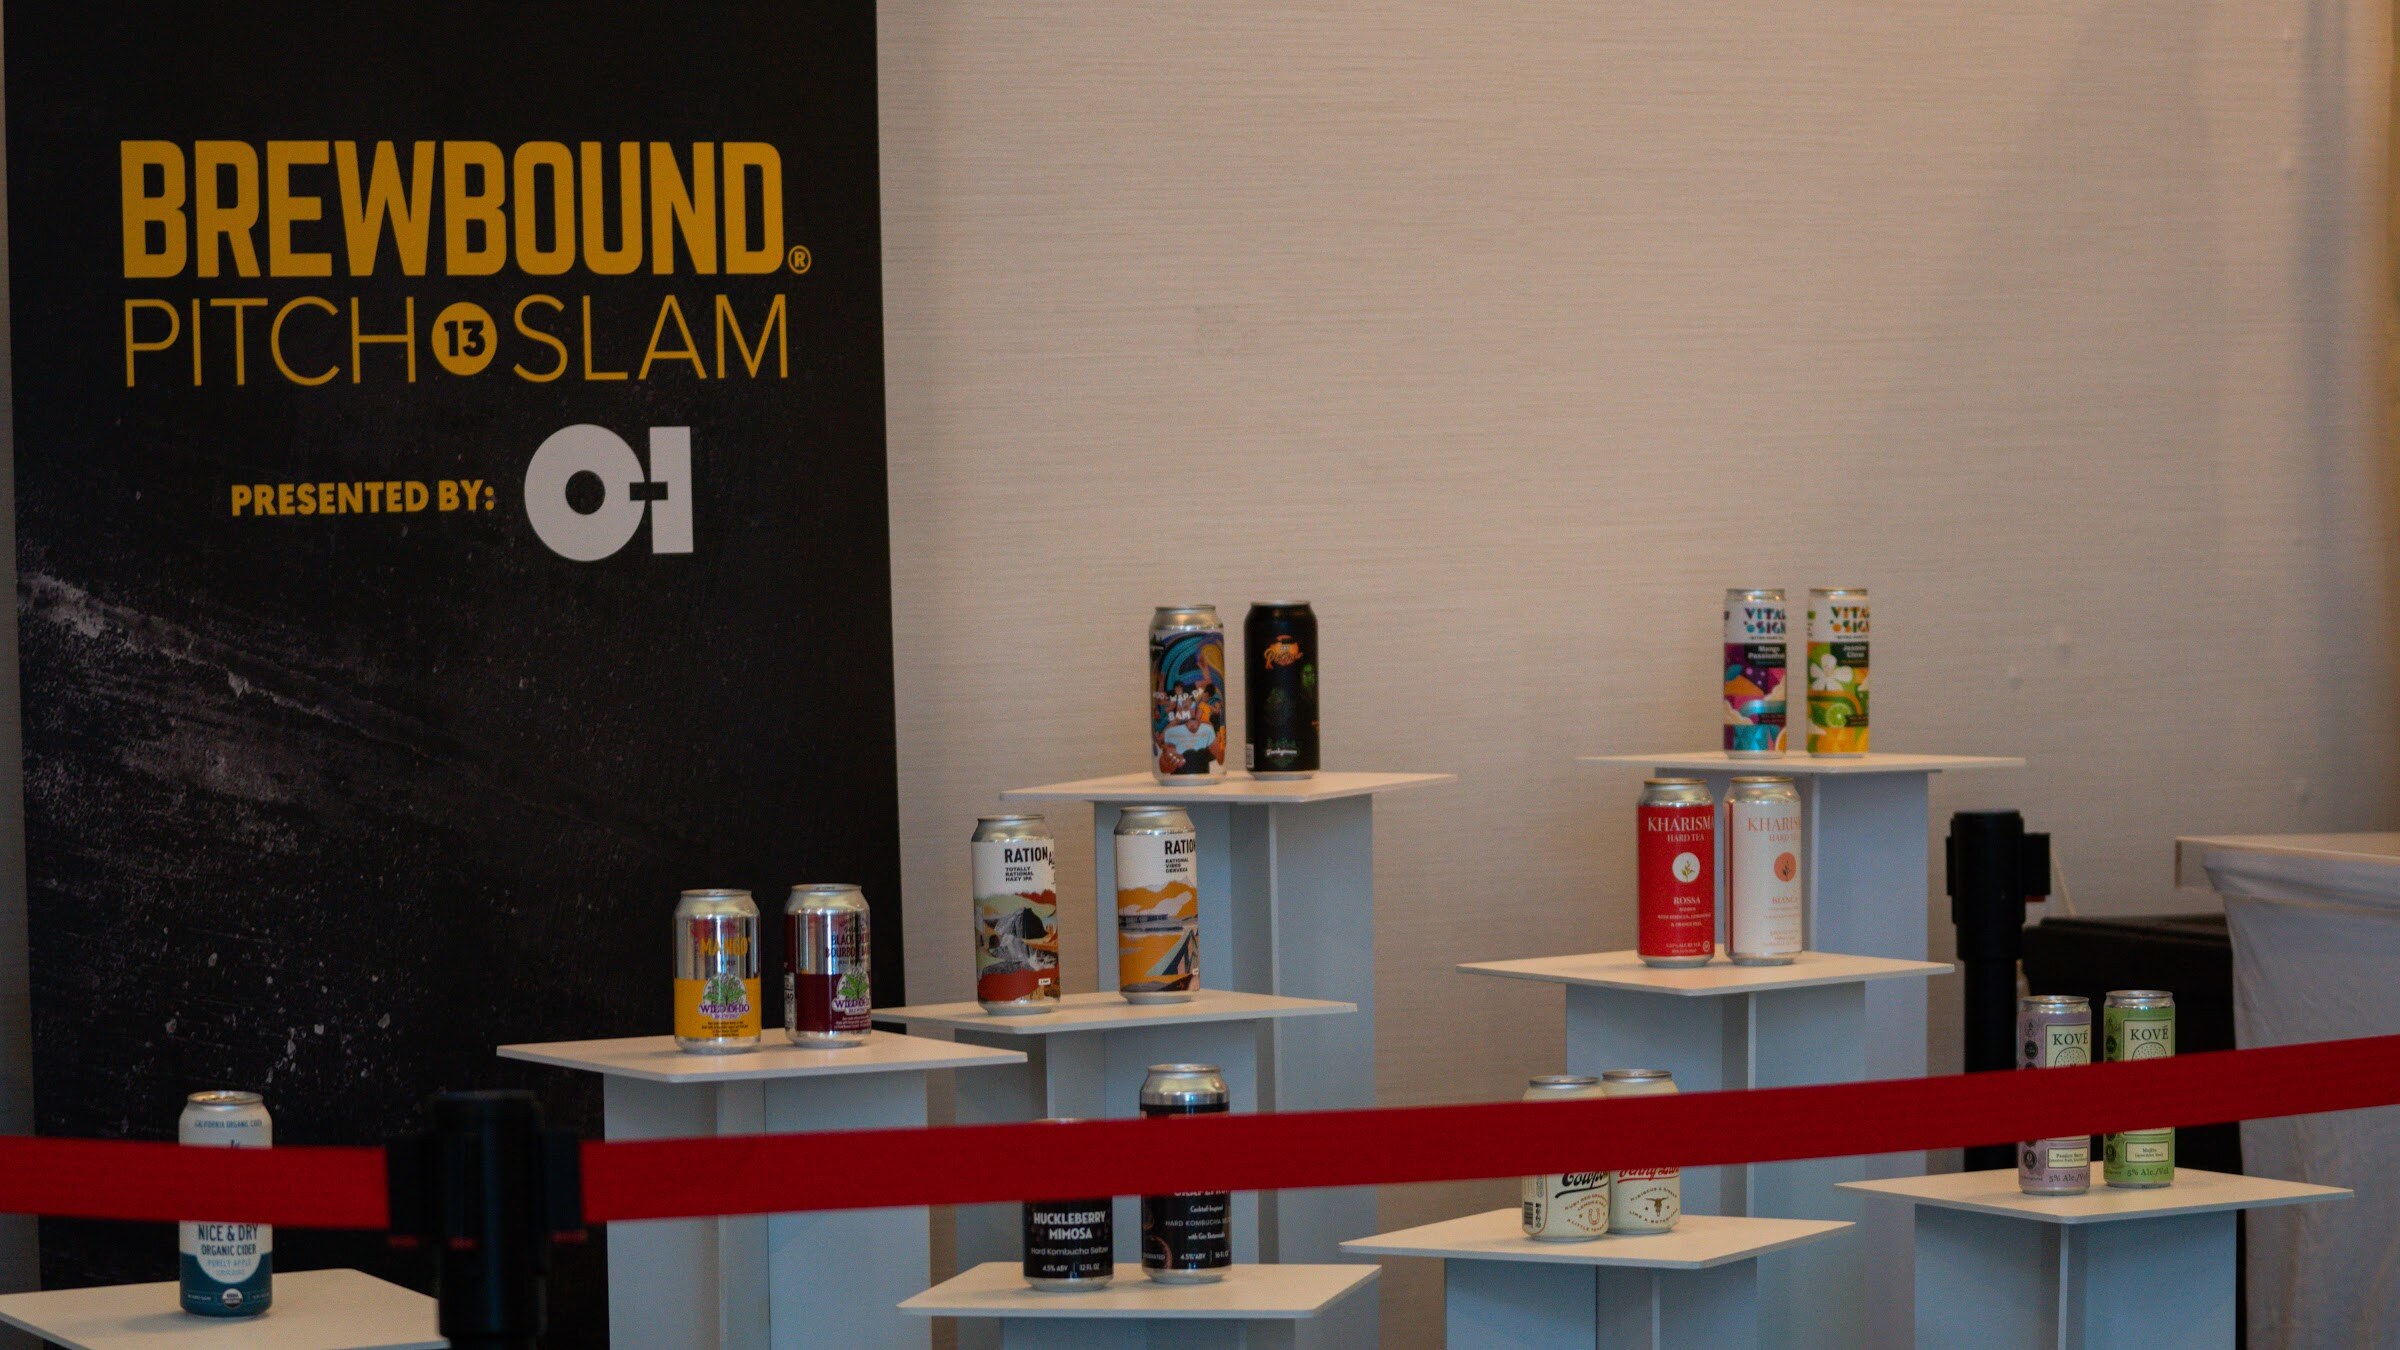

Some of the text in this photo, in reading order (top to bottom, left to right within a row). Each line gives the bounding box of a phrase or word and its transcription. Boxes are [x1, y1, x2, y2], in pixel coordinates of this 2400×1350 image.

[123, 293, 790, 388] PITCH 13 SLAM
[230, 478, 497, 518] PRESENTED BY:
[1648, 816, 1714, 832] KHARISM
[1667, 833, 1705, 842] HARD TEA
[1674, 896, 1701, 905] ROSSA
[700, 1003, 750, 1013] WILD OHIO
[2053, 1031, 2089, 1046] KOVÉ
[2130, 1026, 2169, 1041] KOVÉ
[1033, 1211, 1106, 1225] HUCKLEBERRY
[1165, 1219, 1184, 1227] HARD
[1185, 1218, 1221, 1227] KOMBUCHA
[198, 1223, 258, 1242] NICE & DRY
[1048, 1227, 1093, 1241] MIMOSA
[201, 1243, 257, 1256] ORGANIC CIDER
[1031, 1246, 1109, 1256] Hard Kombucha Seltzer
[1056, 1264, 1069, 1272] ABV
